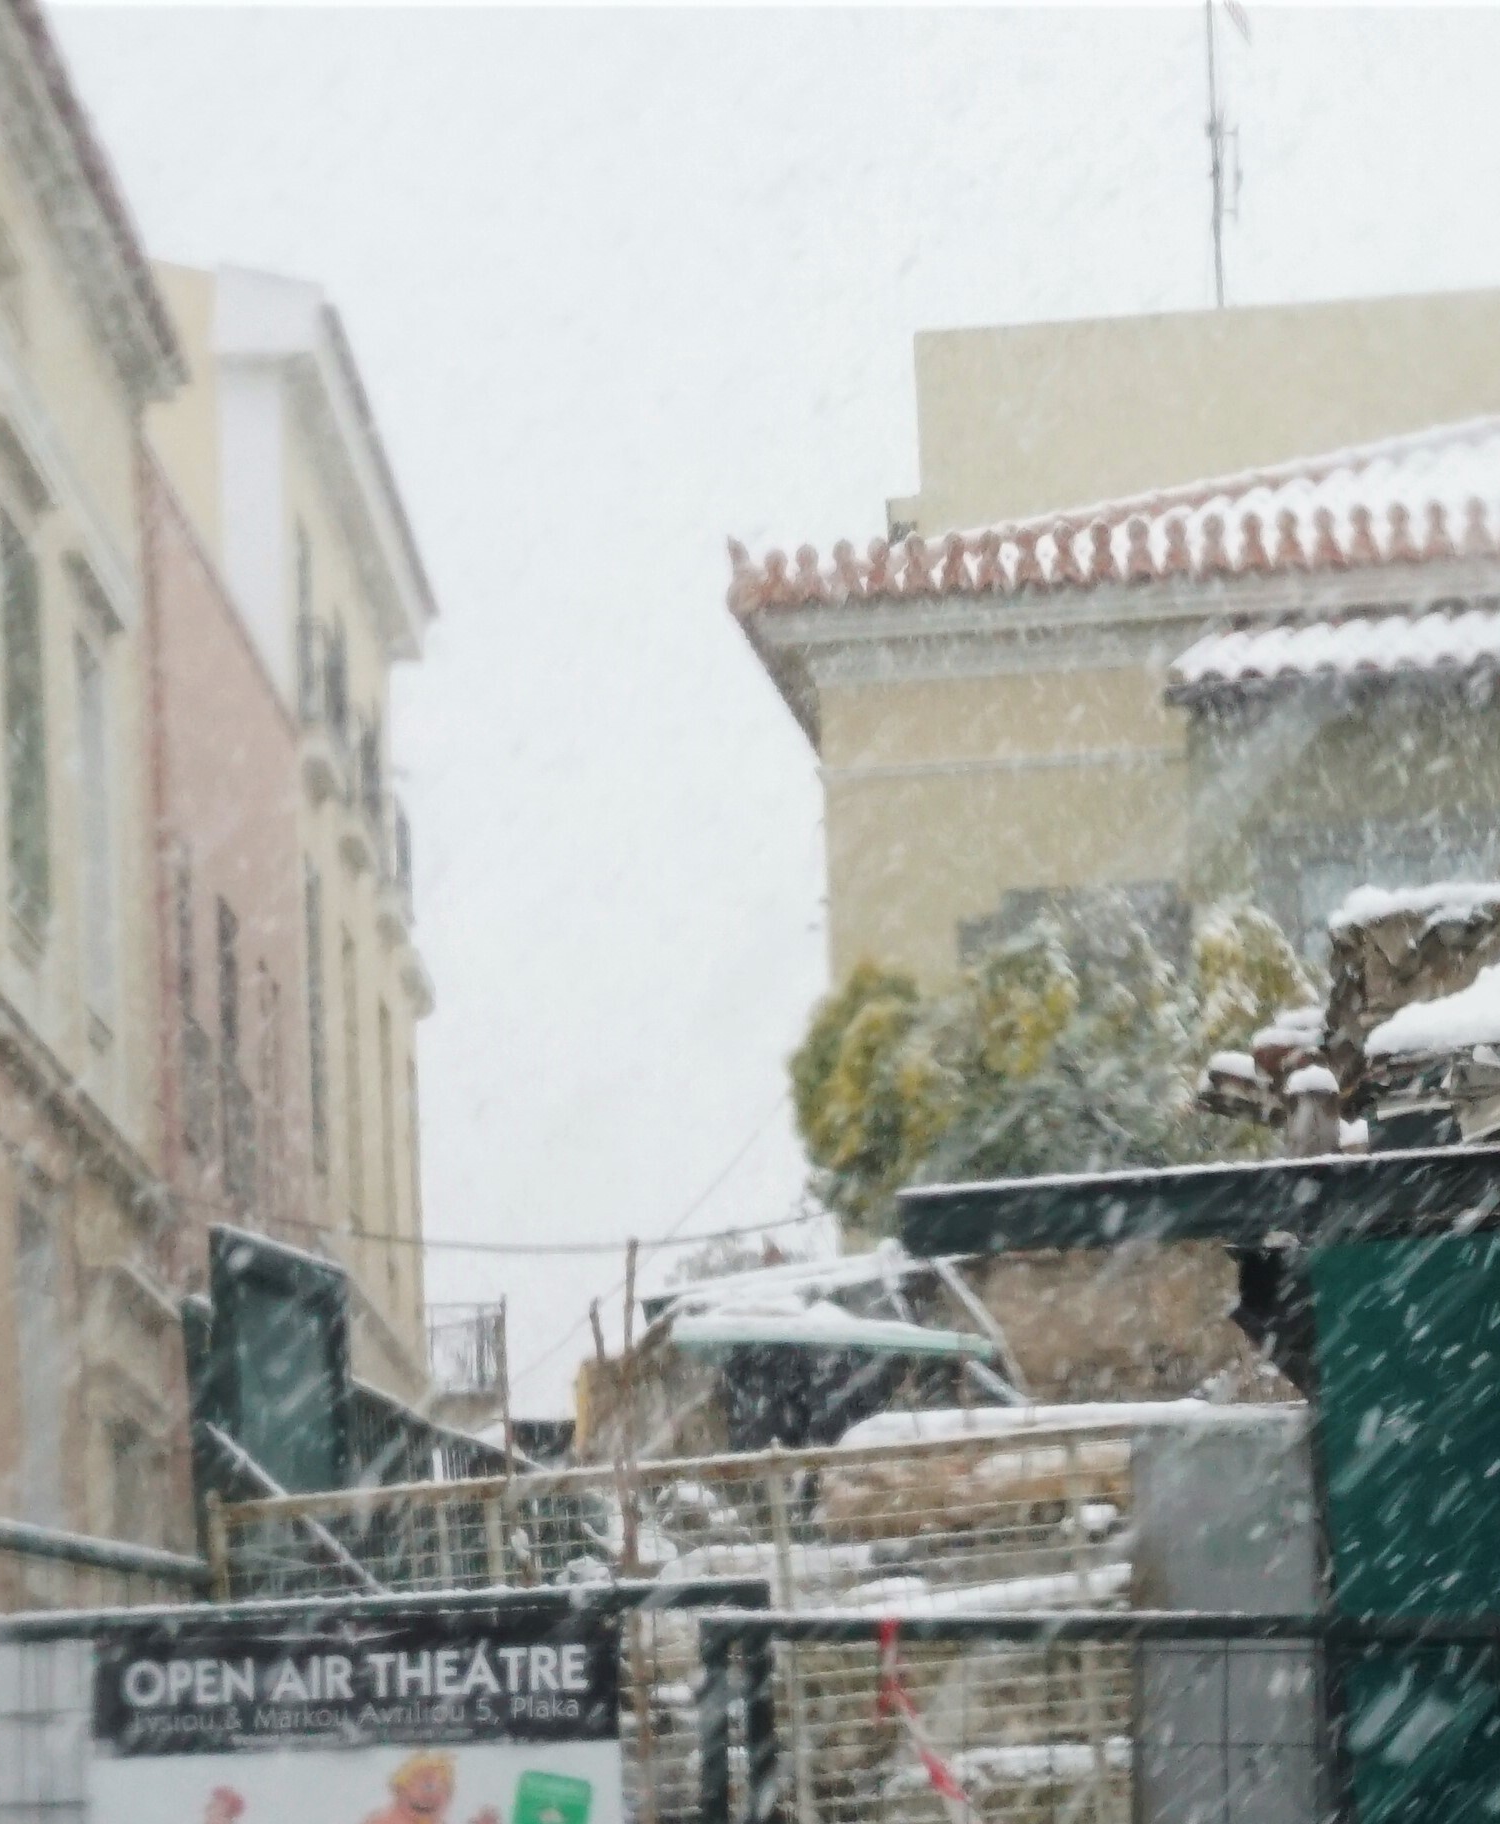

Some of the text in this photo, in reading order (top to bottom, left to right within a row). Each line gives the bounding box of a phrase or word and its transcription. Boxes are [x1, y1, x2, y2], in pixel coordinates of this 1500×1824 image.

[124, 1644, 590, 1706] OPEN AIR THEATRE
[475, 1697, 500, 1725] 5,
[511, 1696, 580, 1720] Plaka
